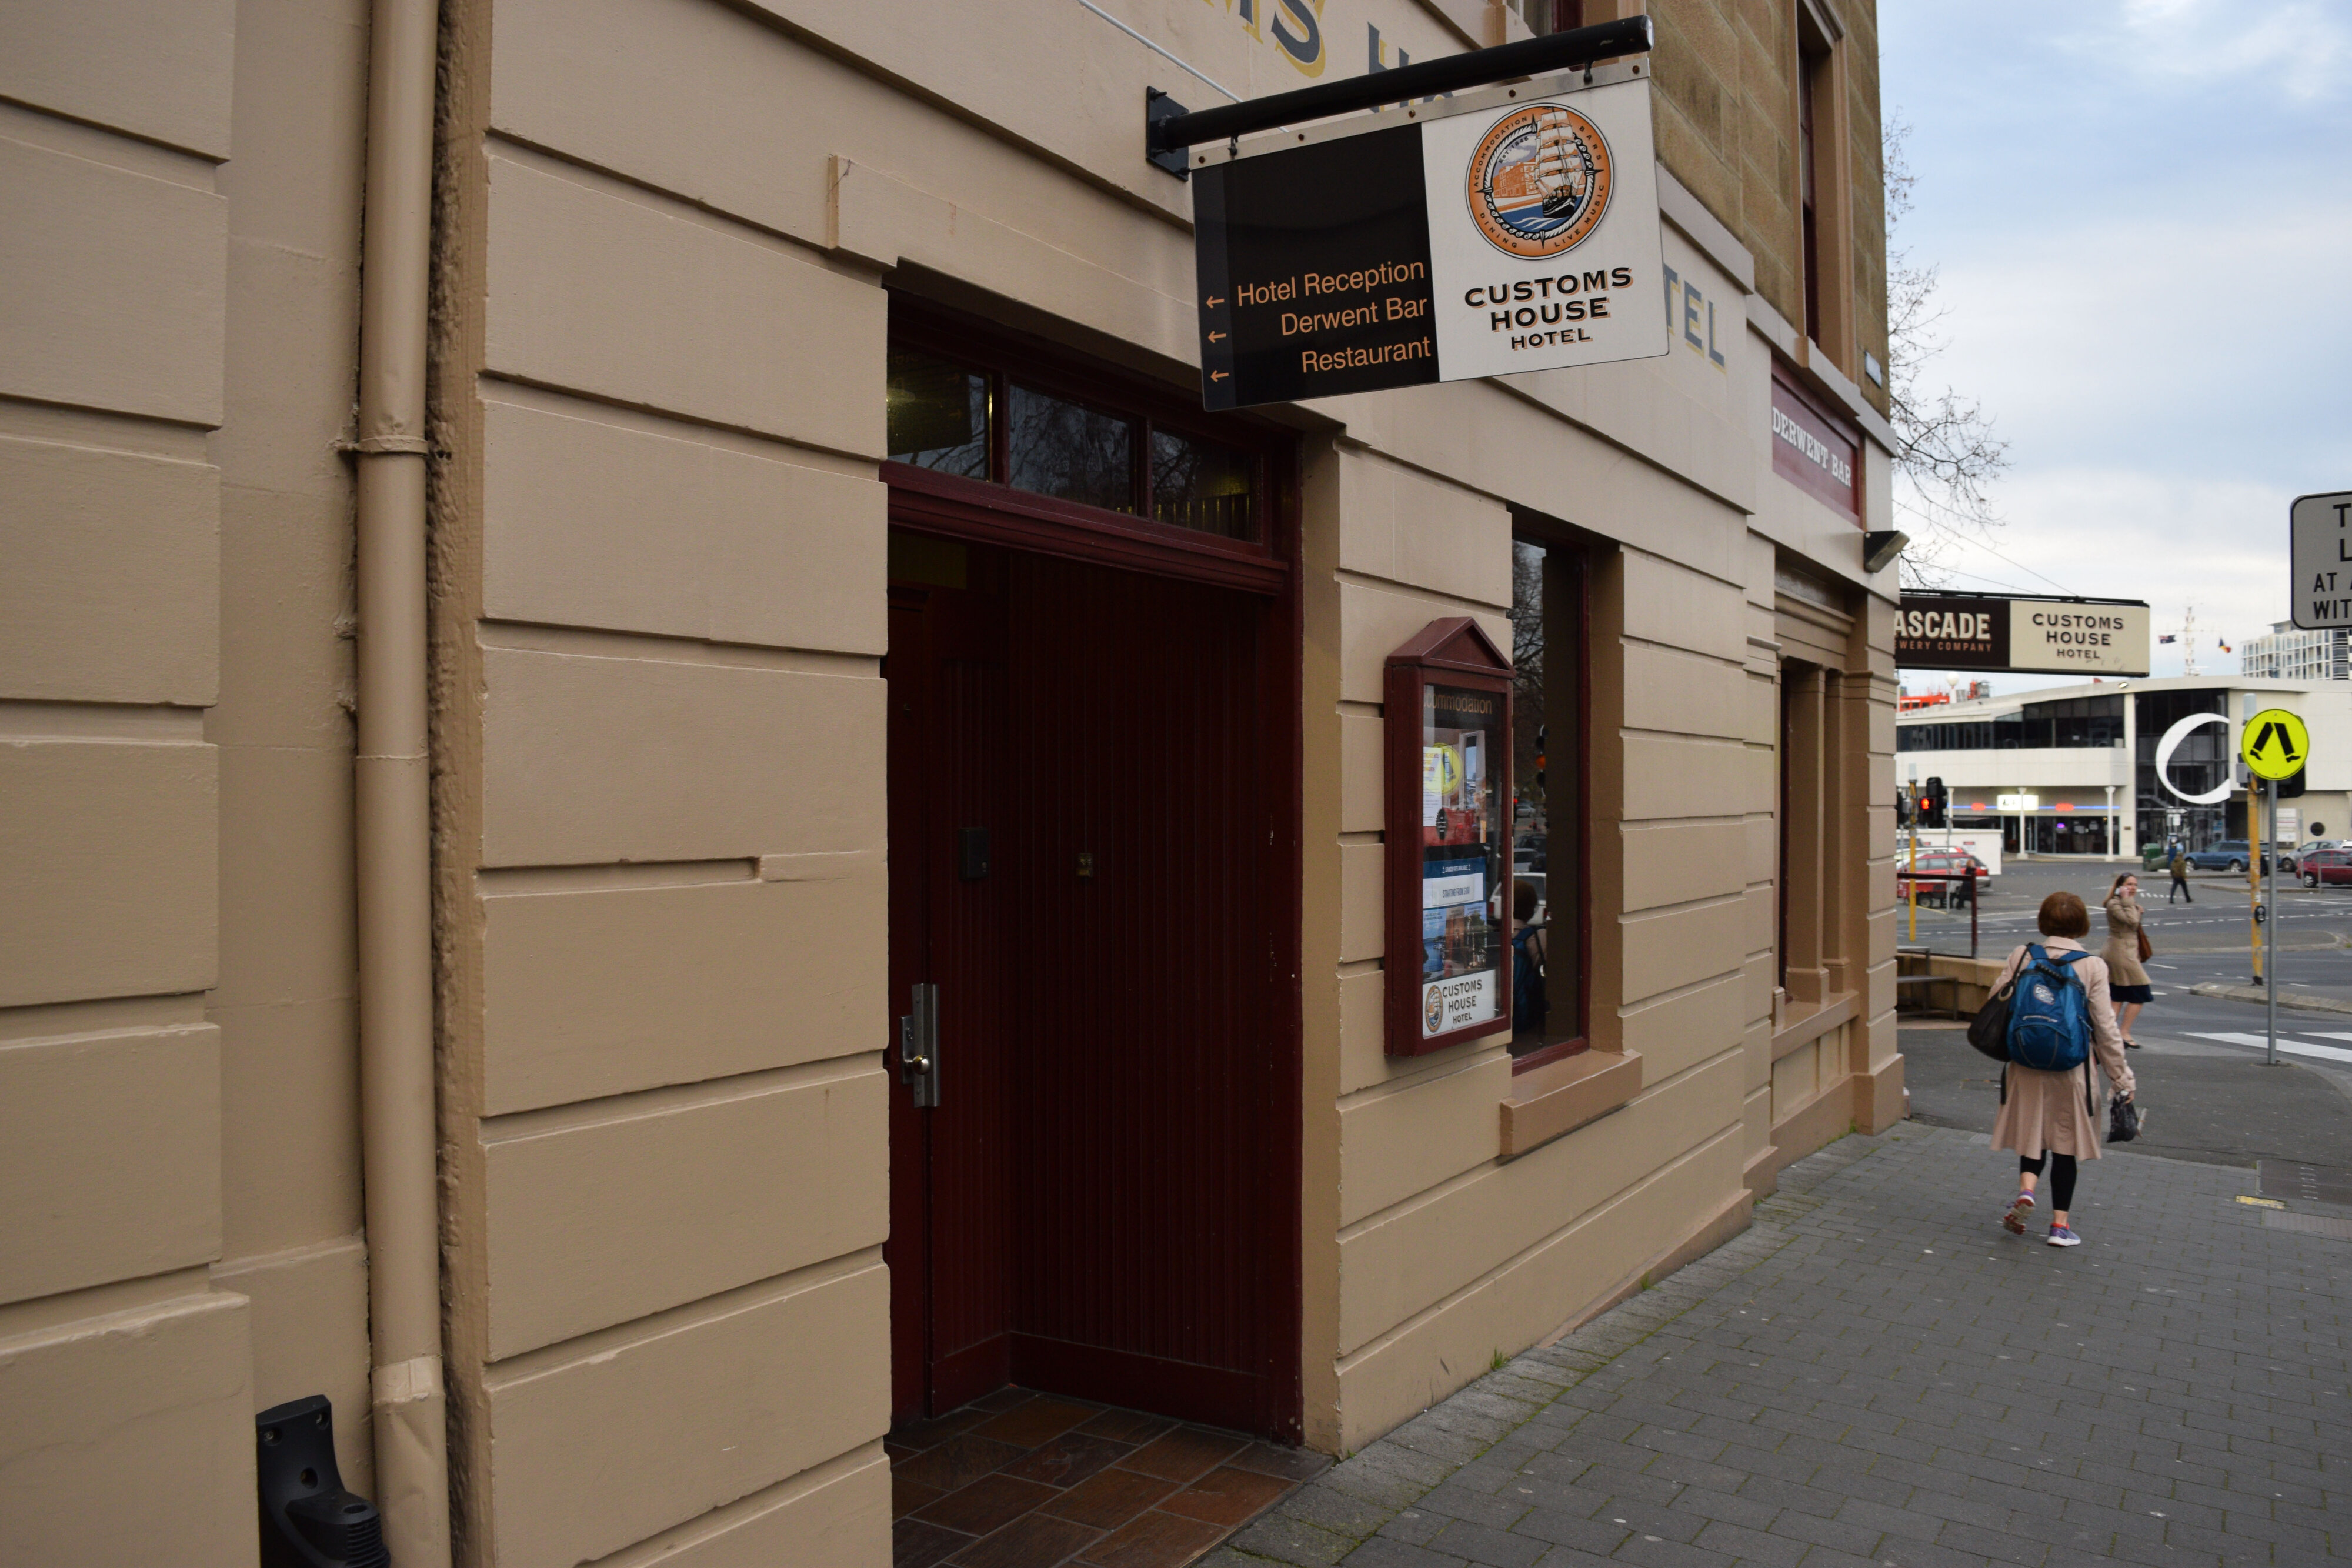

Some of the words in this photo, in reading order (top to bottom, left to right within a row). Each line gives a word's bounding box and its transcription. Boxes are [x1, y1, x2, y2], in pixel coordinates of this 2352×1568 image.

[1474, 116, 1527, 188] ACCOMMODATION
[1511, 136, 1529, 149] 1846
[1579, 126, 1602, 161] BARS
[1480, 212, 1517, 248] DINING
[1554, 228, 1582, 248] LIVE
[1584, 185, 1604, 225] MUSIC
[1237, 276, 1296, 306] Hotel
[1305, 261, 1424, 296] Reception
[1464, 267, 1633, 309] CUSTOMS
[1281, 302, 1379, 336] Derwent
[1386, 297, 1427, 321] Bar
[1490, 296, 1611, 332] HOUSE
[1511, 328, 1593, 351] HOTEL
[1302, 336, 1431, 373] Restaurant
[1773, 406, 1829, 469] DERWENT
[1831, 453, 1851, 488] BAR
[2313, 572, 2337, 592] AT
[2032, 613, 2124, 630] CUSTOMS
[1938, 642, 1991, 652] COMPANY
[2046, 630, 2111, 646] HOUSE
[2057, 648, 2101, 660] HOTEL
[1442, 979, 1482, 998] CUSTOMS
[1448, 996, 1477, 1013] HOUSE
[1453, 1012, 1472, 1024] HOTEL
